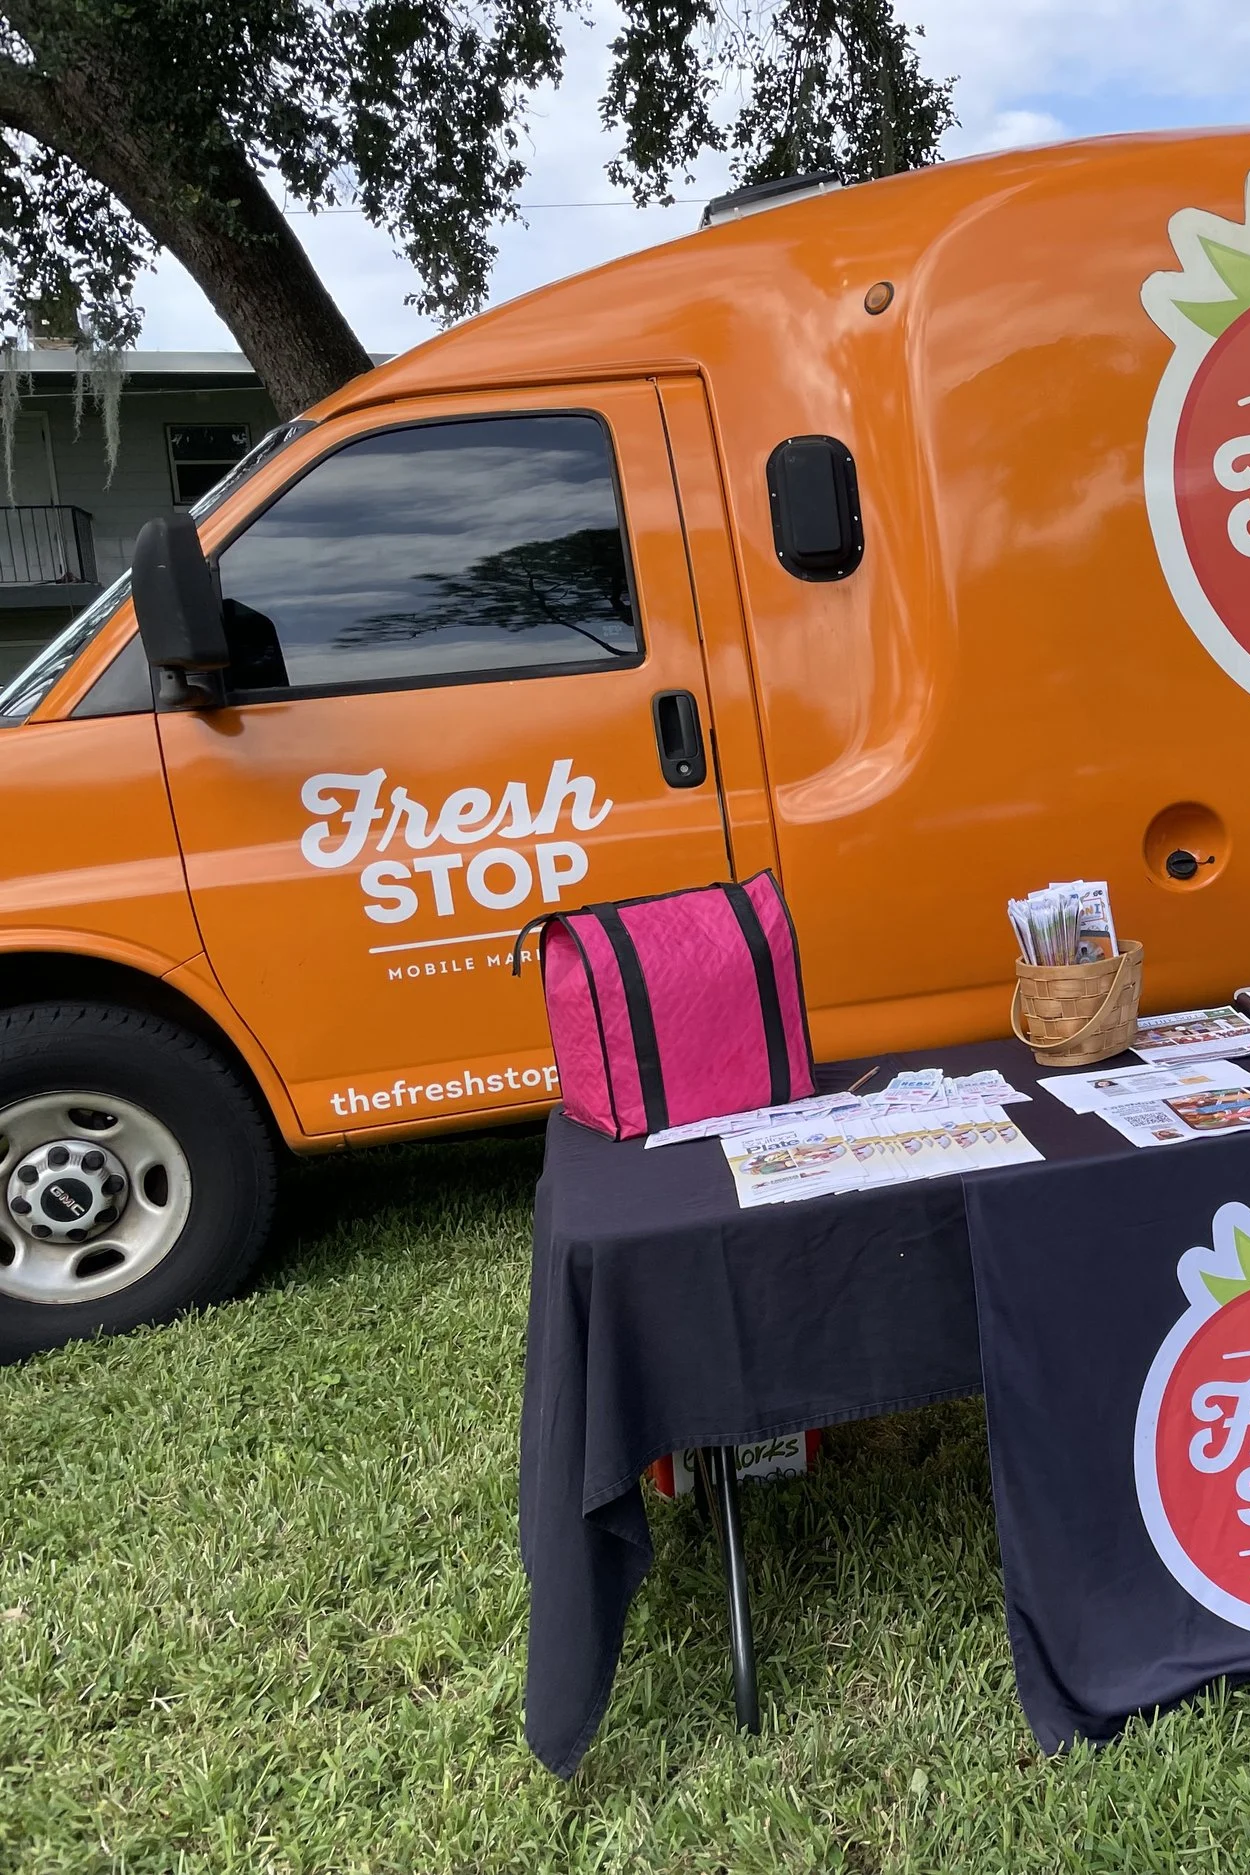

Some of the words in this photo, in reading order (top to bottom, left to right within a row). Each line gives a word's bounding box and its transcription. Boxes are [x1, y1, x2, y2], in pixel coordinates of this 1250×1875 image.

[300, 758, 613, 868] Fresh
[360, 841, 589, 923] STOP
[388, 957, 476, 981] MOBILE
[746, 1139, 800, 1154] Plate
[50, 1185, 85, 1216] GMC
